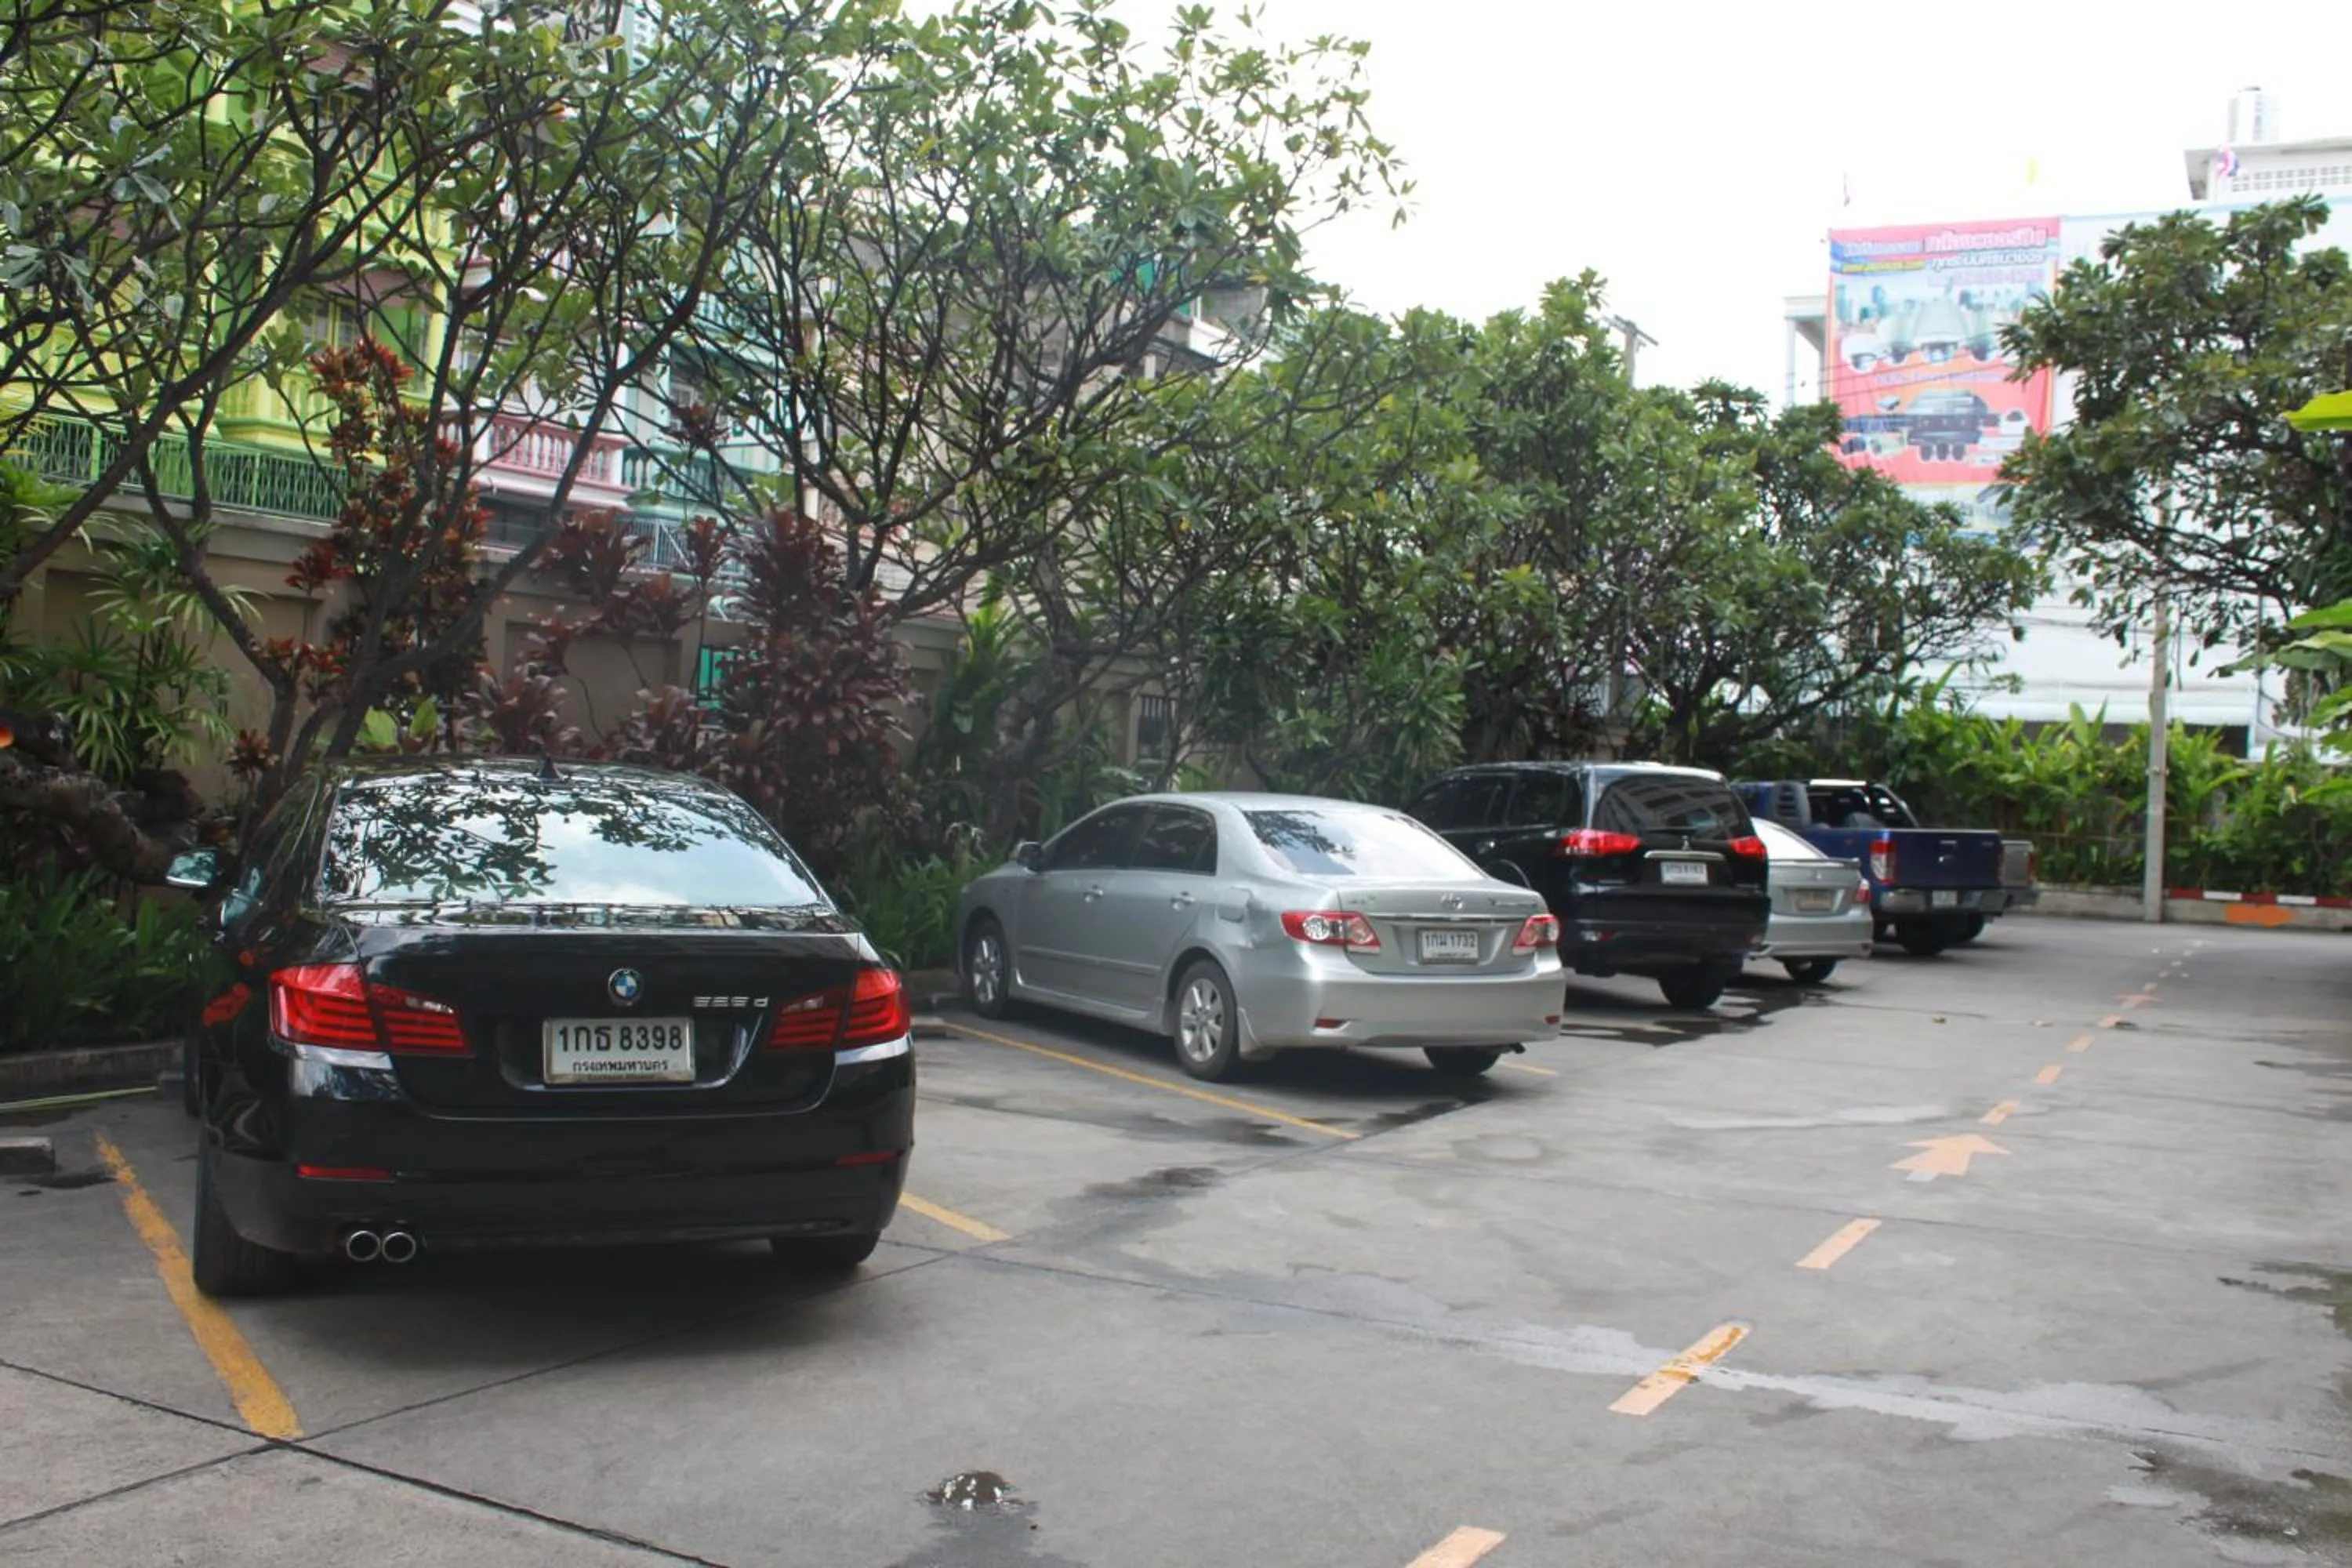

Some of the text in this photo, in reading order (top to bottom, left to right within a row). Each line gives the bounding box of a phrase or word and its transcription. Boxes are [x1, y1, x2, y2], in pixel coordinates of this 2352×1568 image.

[558, 1025, 683, 1052] 1กธ 8398
[572, 1060, 669, 1073] กรงเทพมหานคร
